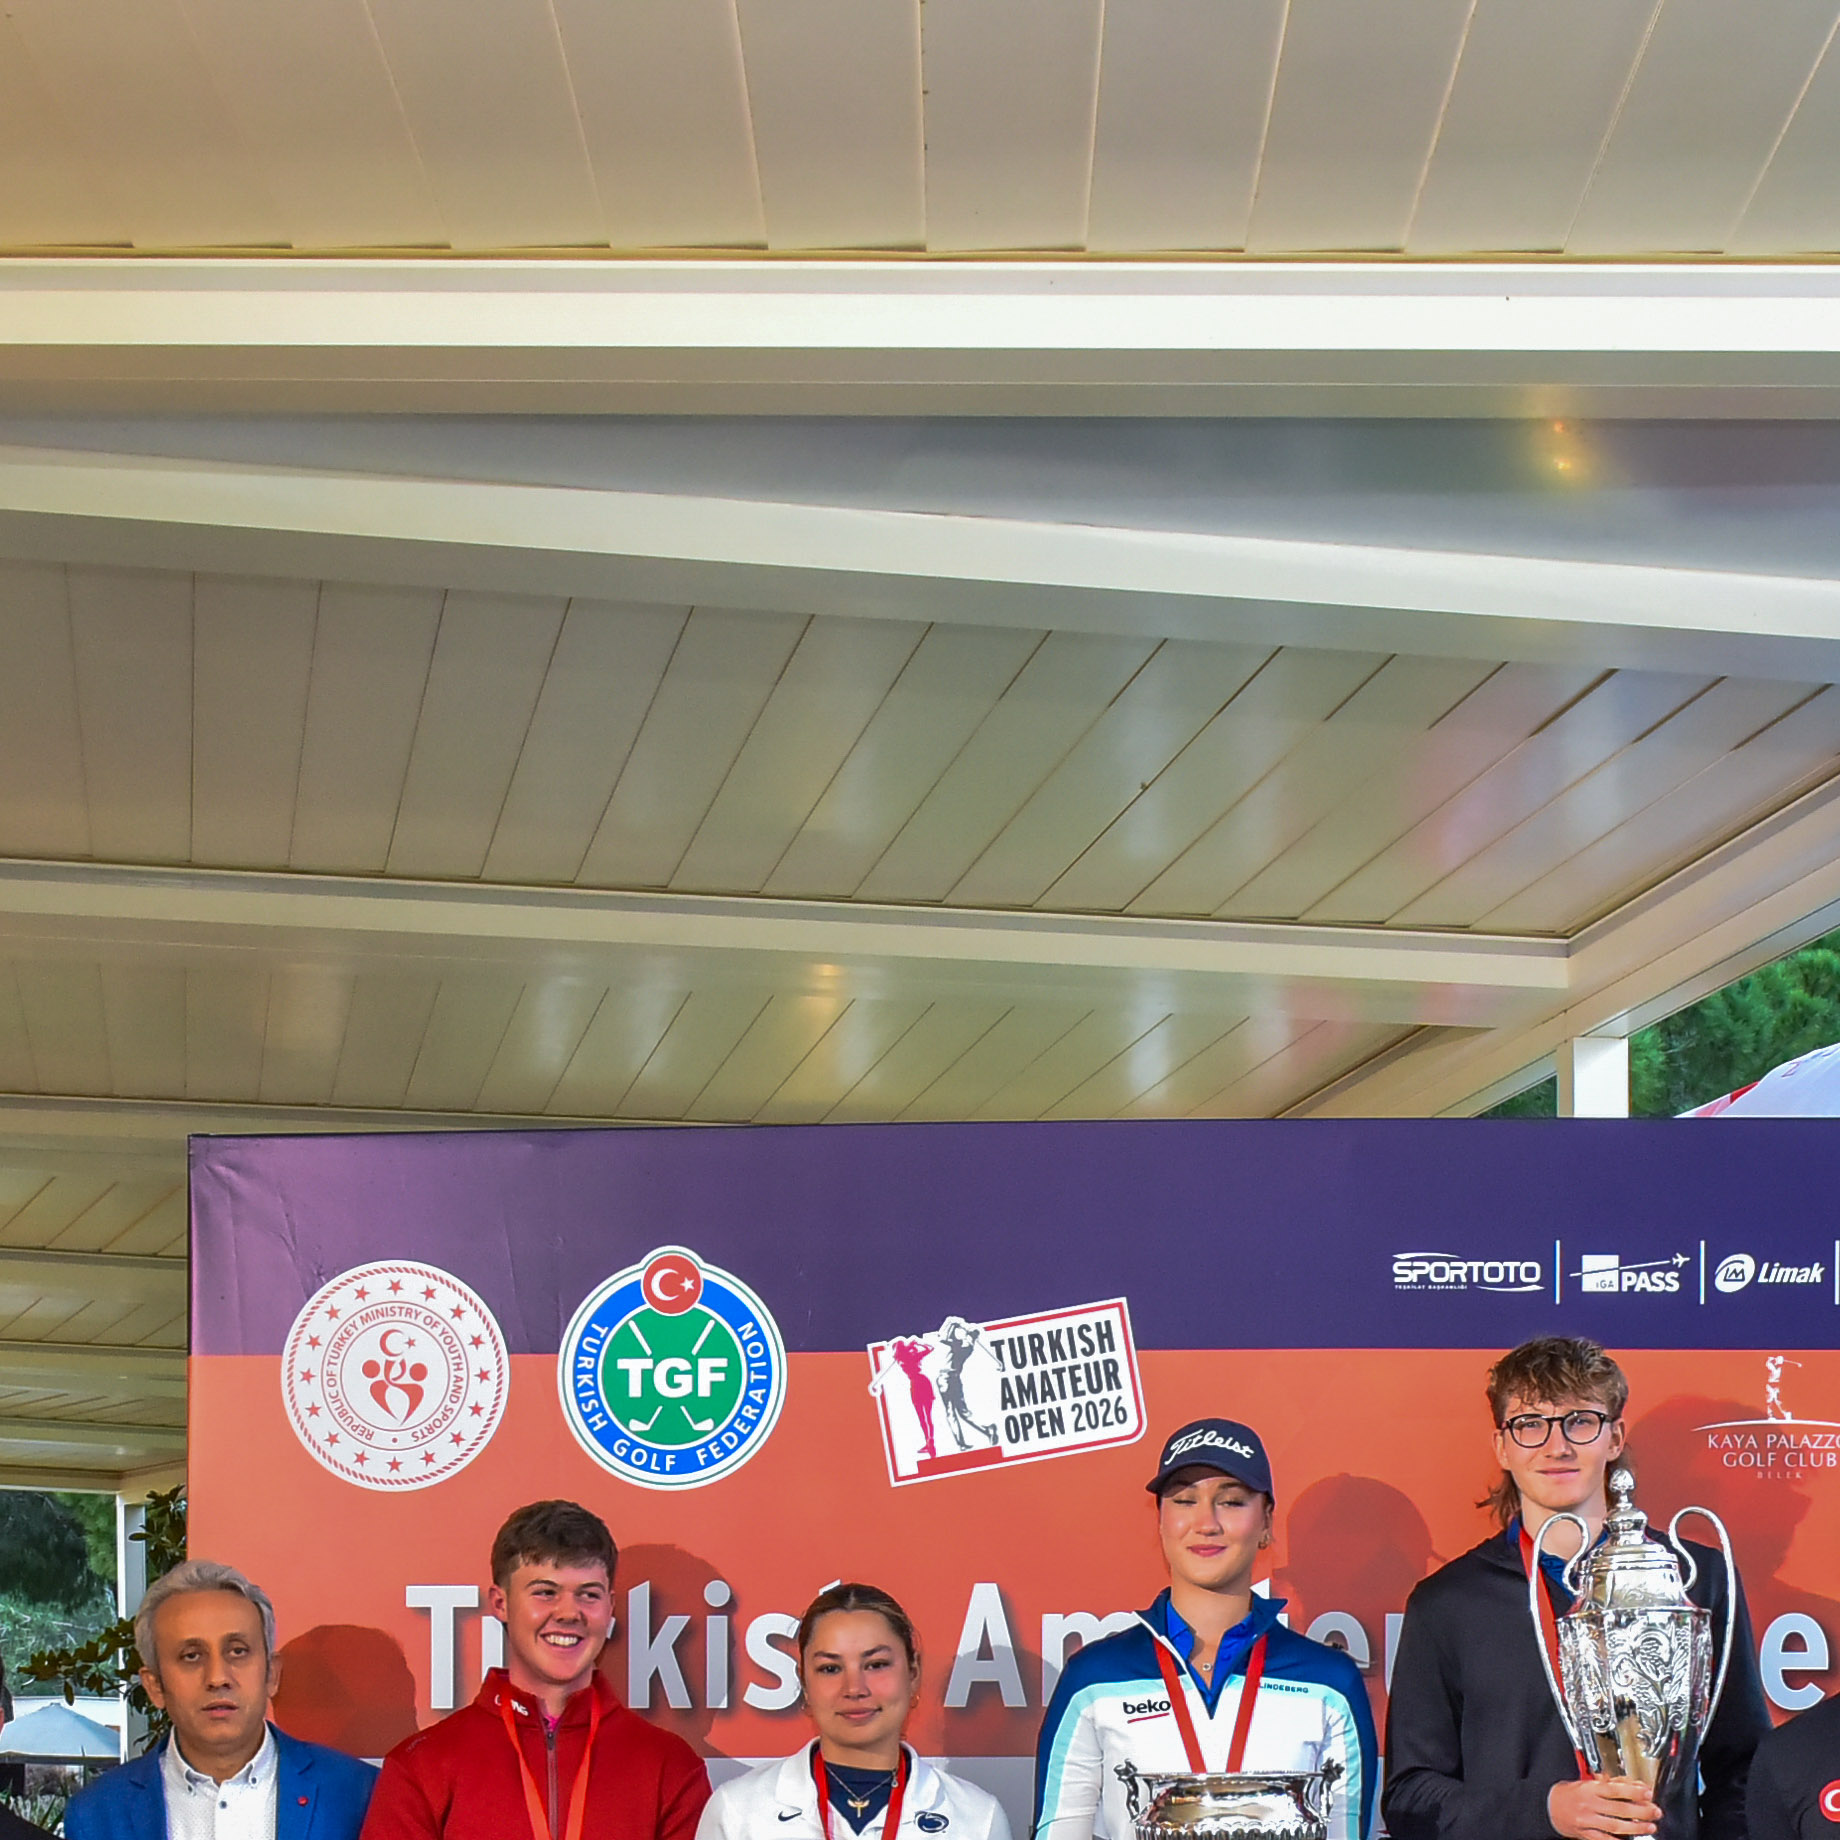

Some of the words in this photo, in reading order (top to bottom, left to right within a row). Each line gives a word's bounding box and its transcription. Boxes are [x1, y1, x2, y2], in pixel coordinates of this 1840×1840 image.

[1393, 1261, 1541, 1283] SPORTOTO
[1622, 1271, 1680, 1292] PASS
[1758, 1261, 1826, 1283] Limak
[360, 1305, 423, 1326] MINISTRY
[423, 1315, 441, 1330] OF
[328, 1320, 360, 1367] TURKEY
[438, 1326, 465, 1371] YOUTH
[989, 1319, 1117, 1372] TURKISH
[325, 1369, 338, 1388] OF
[449, 1374, 465, 1404] AND
[617, 1357, 729, 1399] TGF
[1000, 1358, 1123, 1411] AMATEUR
[576, 1322, 610, 1432] TURKISH
[613, 1438, 677, 1472] GOLF
[696, 1321, 768, 1467] FEDERATION
[328, 1389, 375, 1441] REPUBLIC
[411, 1404, 454, 1443] SPORTS
[1004, 1406, 1066, 1444] OPEN
[1071, 1395, 1128, 1433] 2026
[1164, 1428, 1255, 1465] Titleist
[1707, 1433, 1758, 1449] KAYA
[1722, 1451, 1780, 1468] GOLF
[1784, 1451, 1838, 1468] CLUB
[1123, 1699, 1171, 1715] beko
